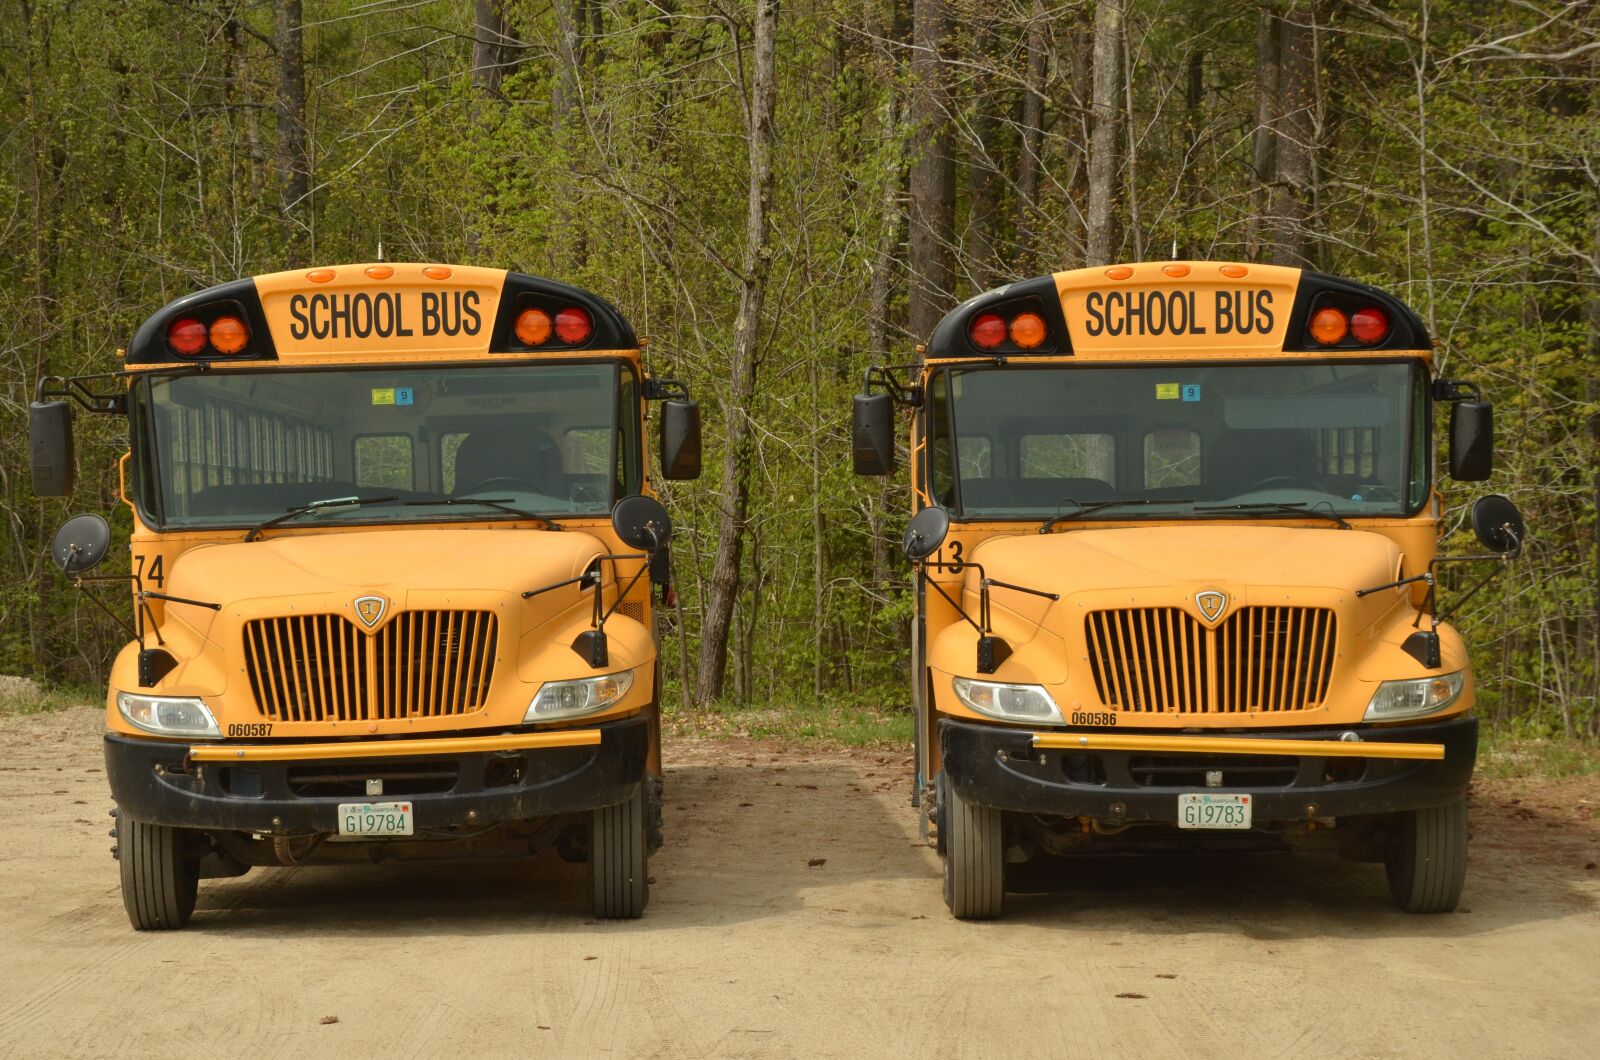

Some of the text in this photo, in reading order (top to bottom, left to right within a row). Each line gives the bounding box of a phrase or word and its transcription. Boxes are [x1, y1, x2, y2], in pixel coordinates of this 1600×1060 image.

[290, 290, 482, 340] SCHOOL BUS
[1085, 289, 1274, 336] SCHOOL BUS
[401, 391, 408, 400] 9
[1188, 388, 1195, 397] 9
[135, 555, 164, 589] 74
[1071, 711, 1117, 726] 060586
[228, 723, 273, 737] 060587
[346, 814, 405, 833] G19784
[1185, 805, 1244, 824] G19783
